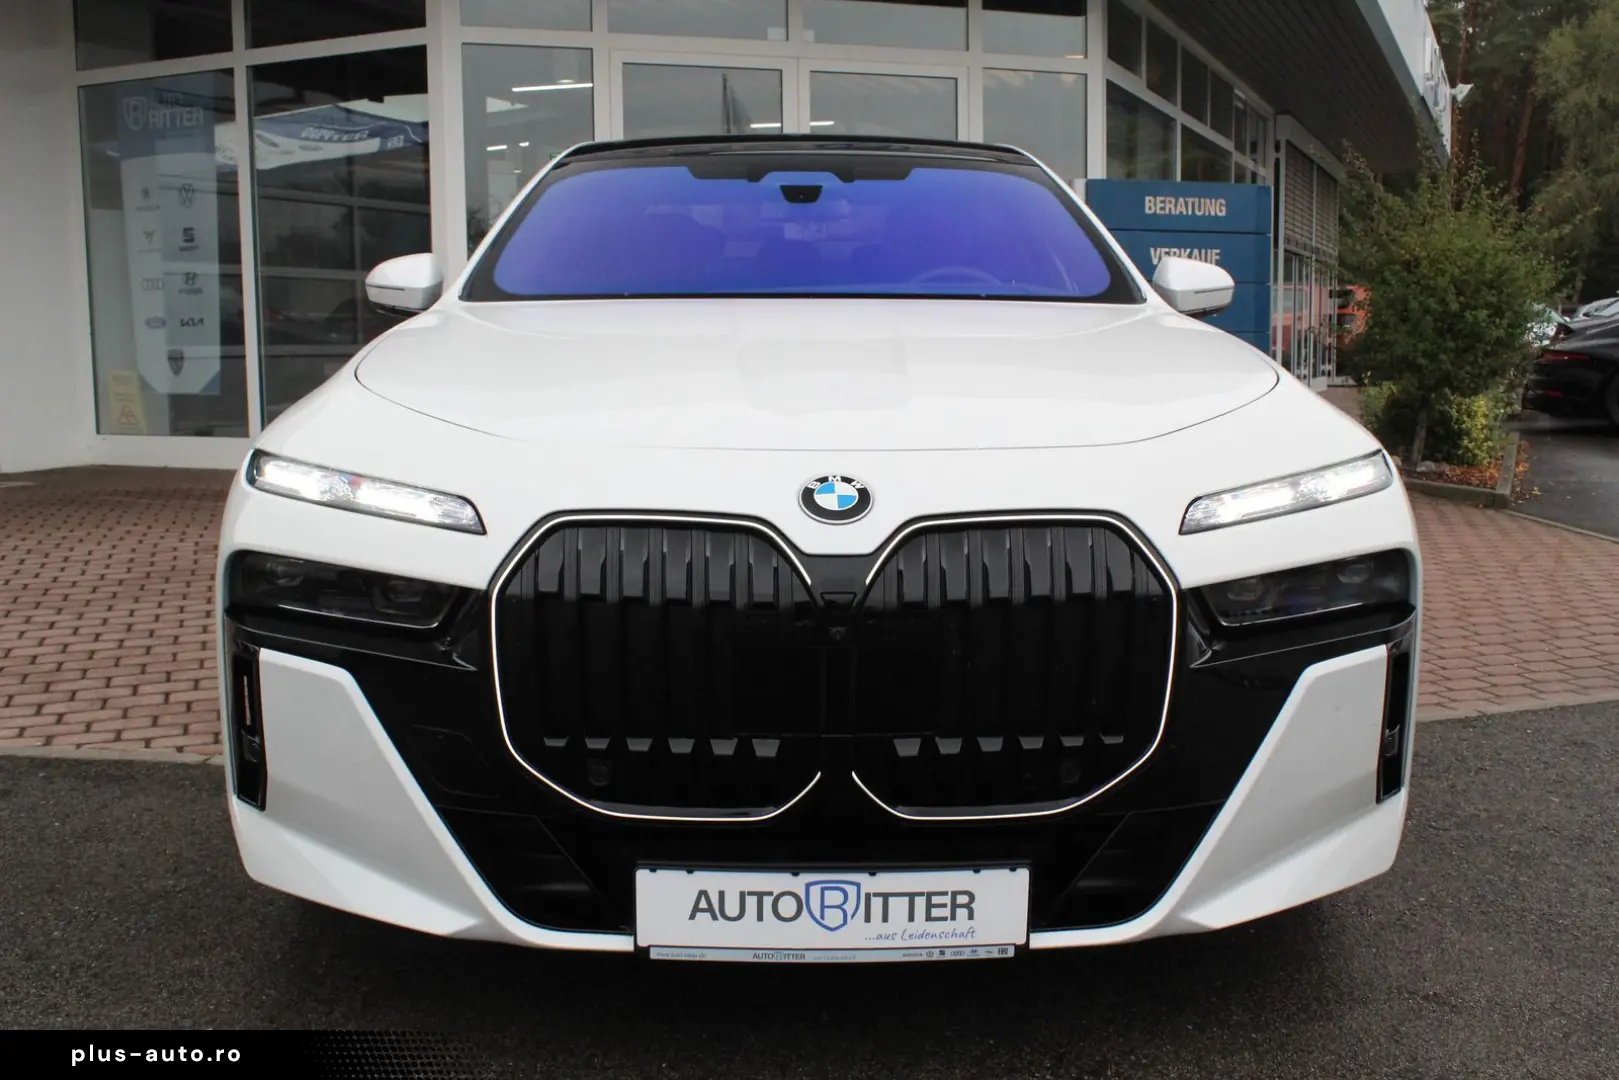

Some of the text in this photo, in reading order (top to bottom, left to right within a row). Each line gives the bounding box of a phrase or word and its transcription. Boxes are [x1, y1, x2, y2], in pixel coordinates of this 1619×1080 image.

[1144, 195, 1227, 217] BERATUNG
[806, 475, 865, 490] BMW
[900, 927, 977, 941] Leidenschaft
